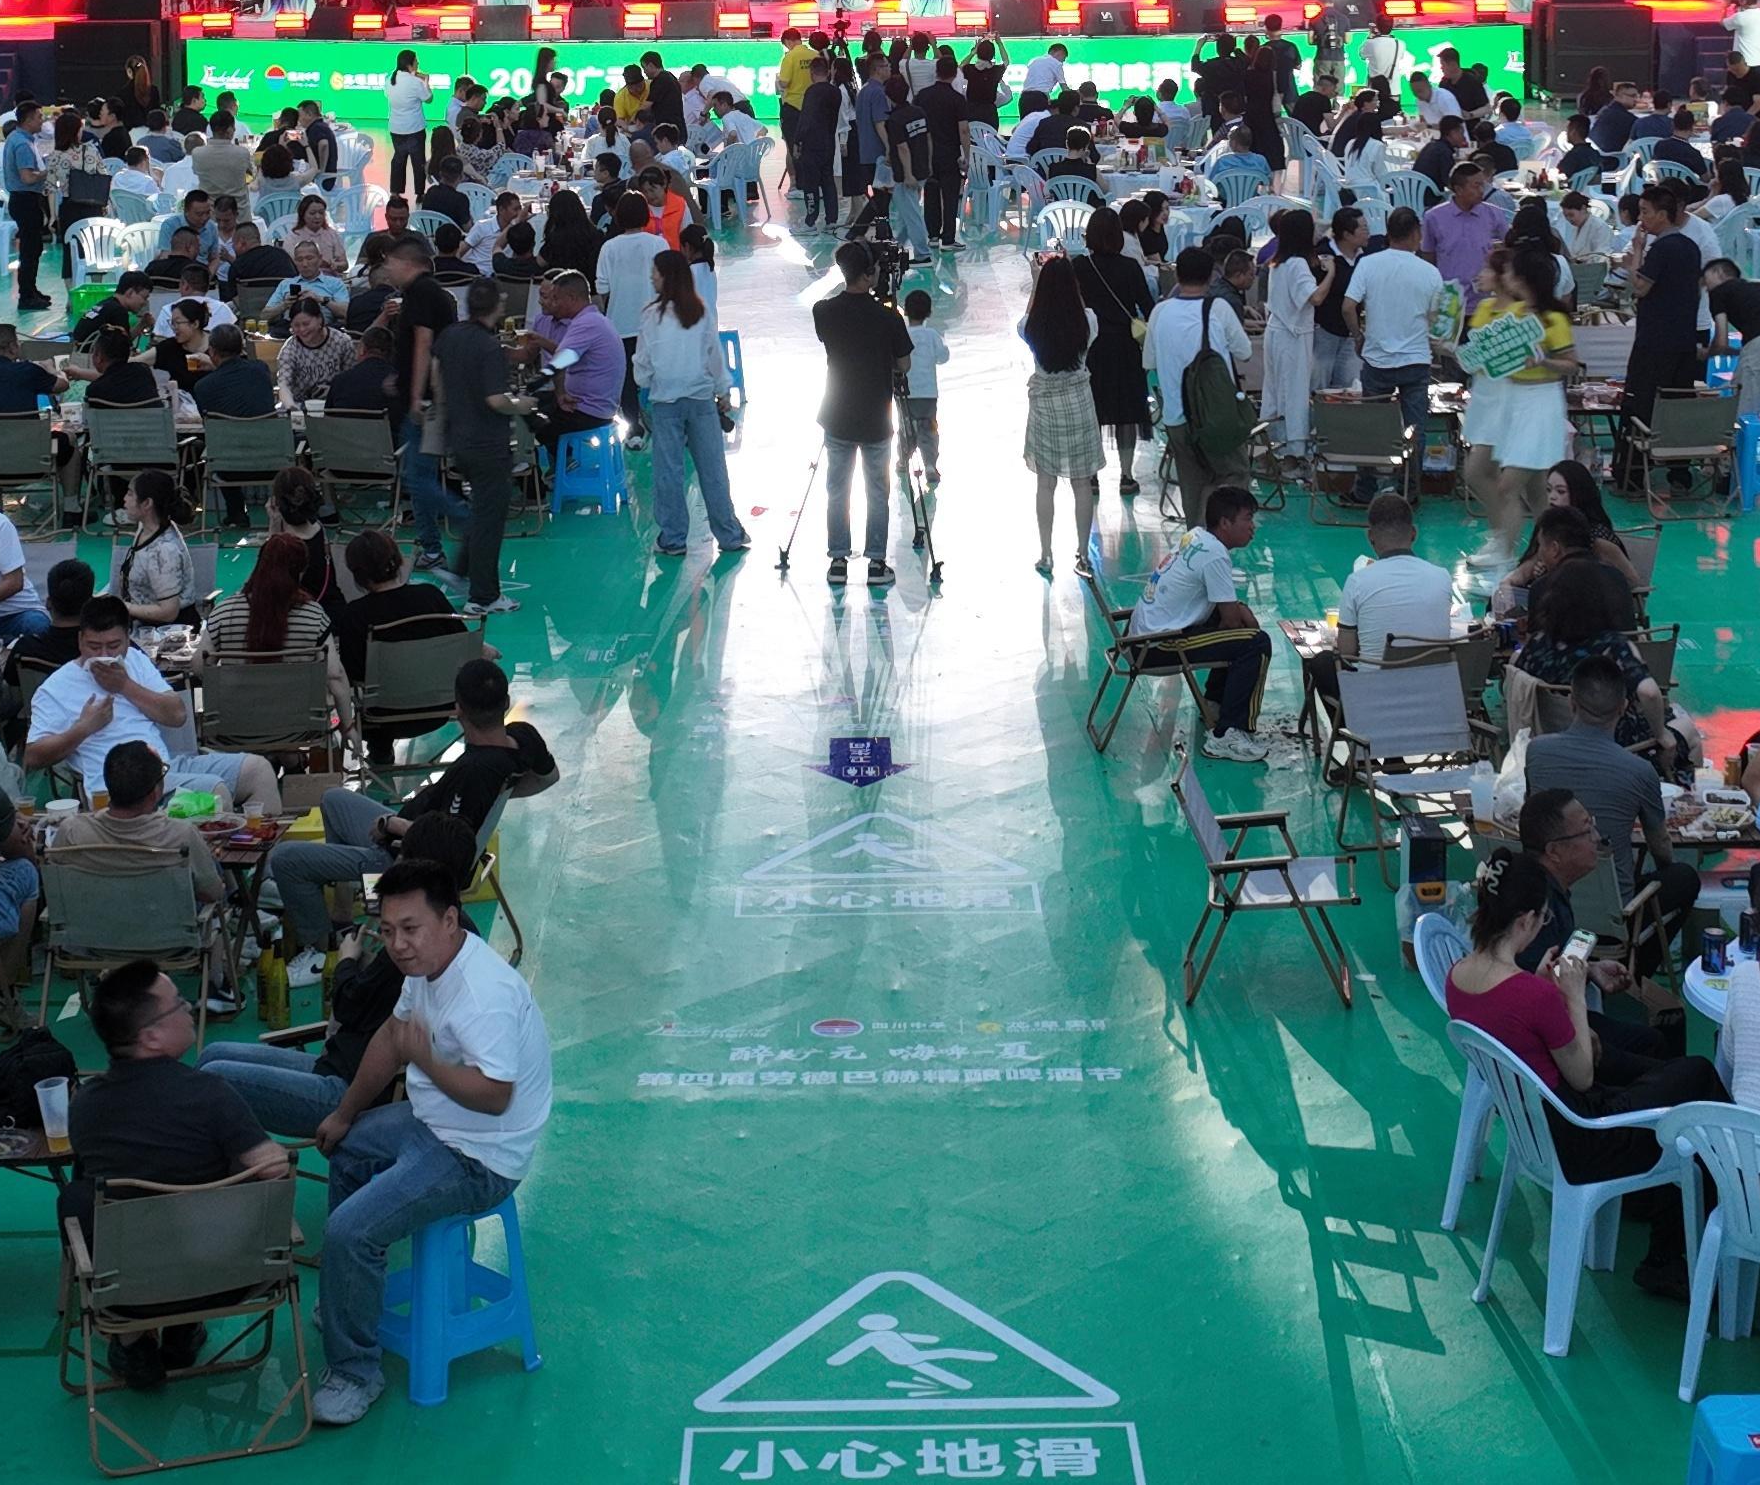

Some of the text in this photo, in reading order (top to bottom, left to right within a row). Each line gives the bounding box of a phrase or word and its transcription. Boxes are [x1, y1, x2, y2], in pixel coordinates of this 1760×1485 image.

[757, 884, 1016, 911] 小心地滑
[637, 1066, 1124, 1087] 第四届劳德巴赫精酿啤酒节
[719, 1436, 1102, 1478] 小心地滑
